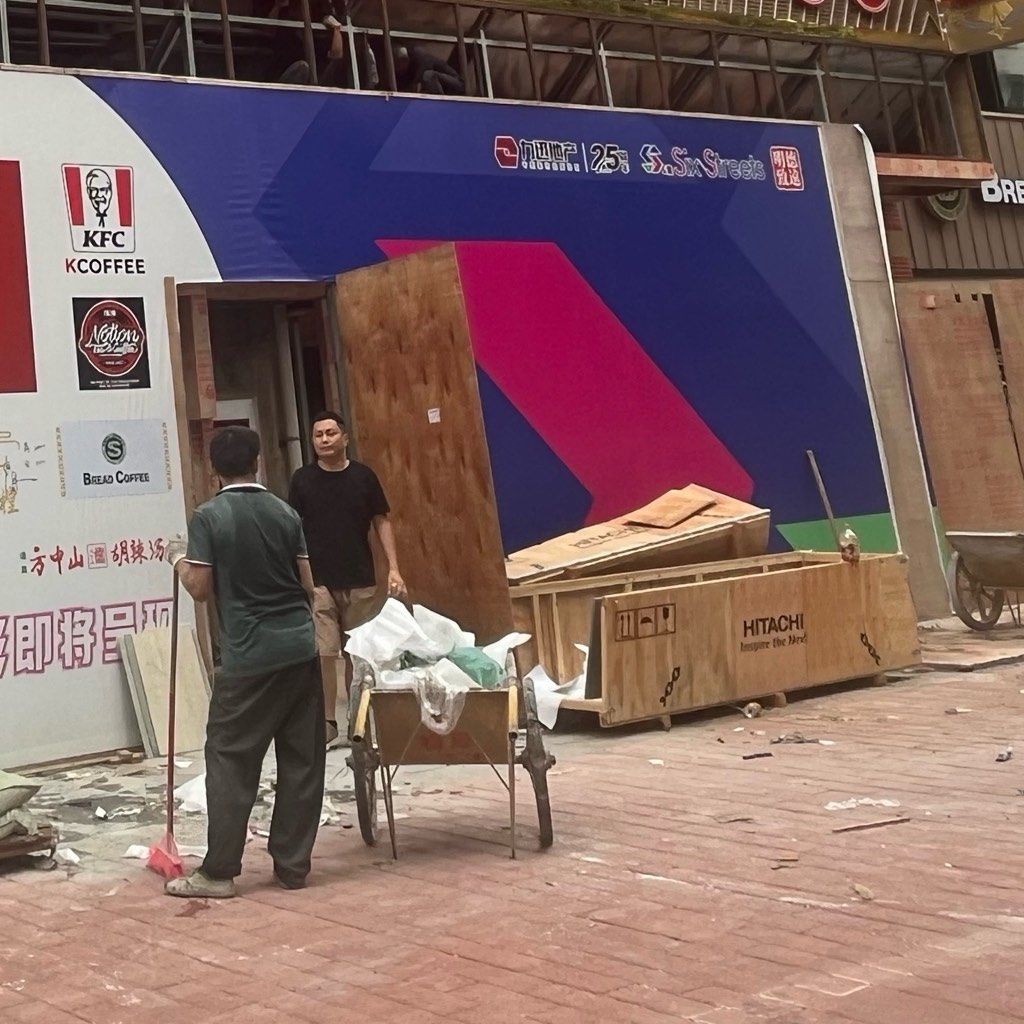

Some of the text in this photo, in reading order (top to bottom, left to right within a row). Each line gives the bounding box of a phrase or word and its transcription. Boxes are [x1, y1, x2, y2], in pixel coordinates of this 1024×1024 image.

[83, 230, 125, 248] KFC
[65, 258, 146, 274] KCOFFEE
[83, 470, 150, 486] BREAD COFFEE
[743, 613, 804, 638] HITACHI
